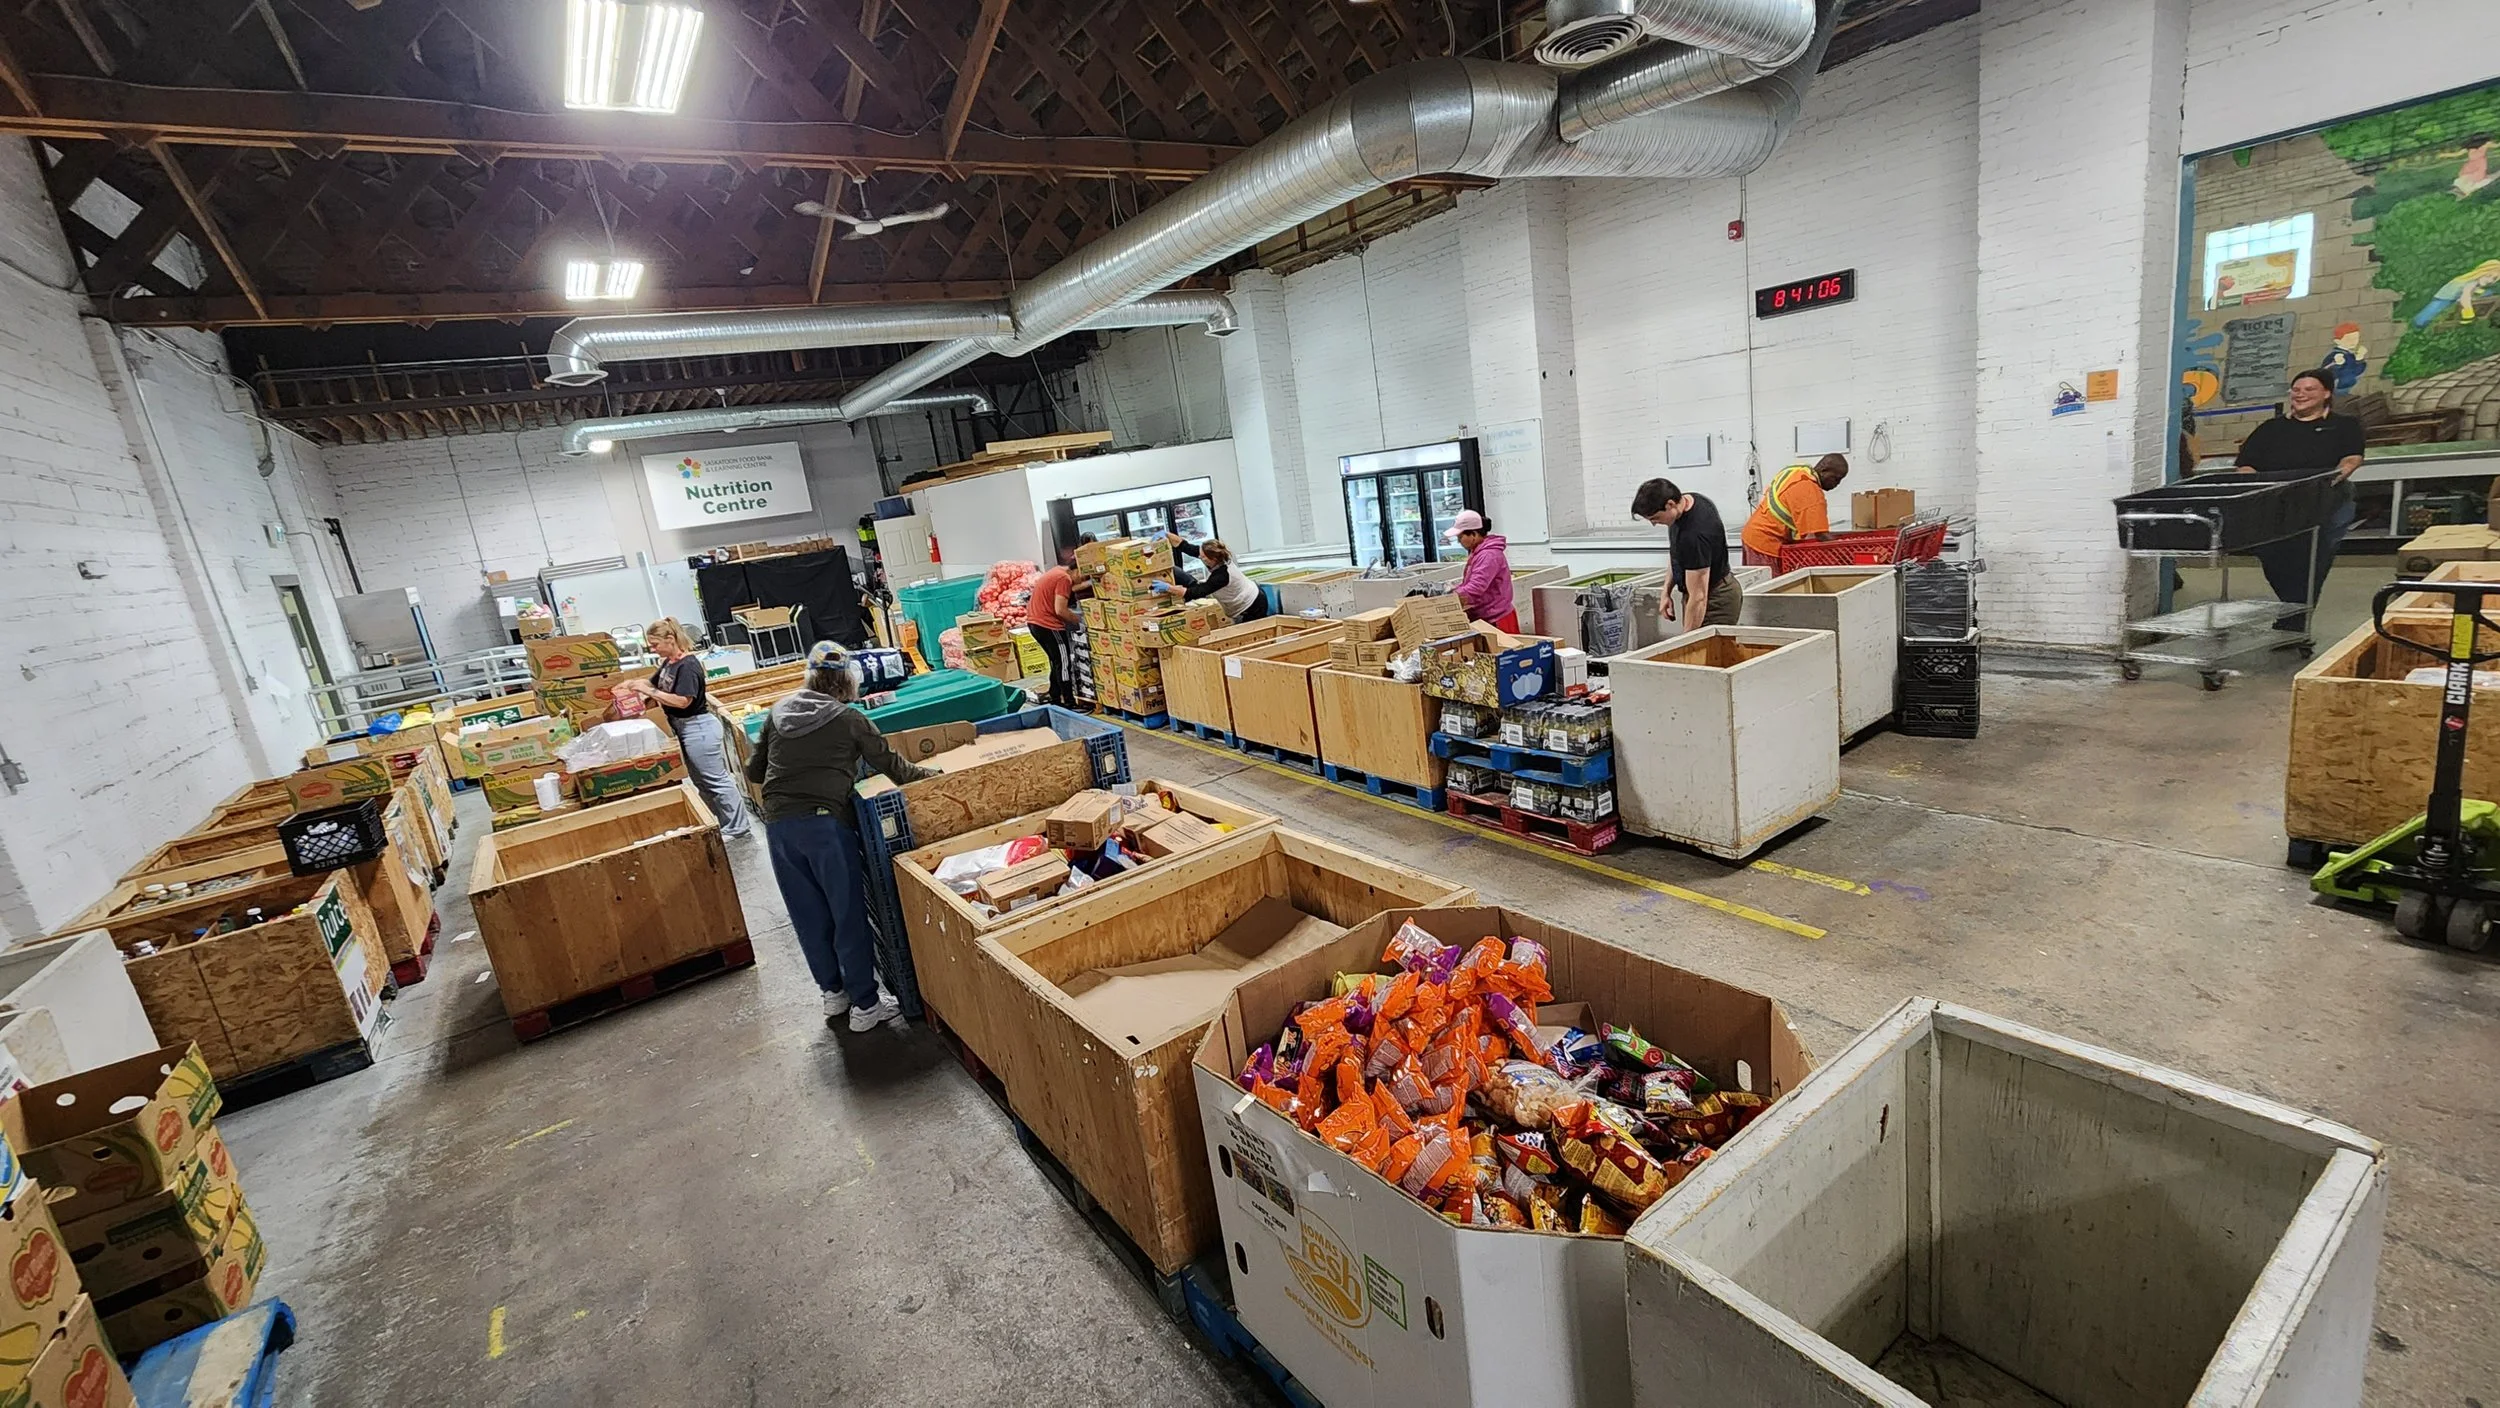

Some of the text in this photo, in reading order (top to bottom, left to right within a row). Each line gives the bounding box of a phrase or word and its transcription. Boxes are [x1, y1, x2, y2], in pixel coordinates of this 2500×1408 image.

[704, 454, 774, 467] SASKATOON FOOD BANK
[711, 463, 743, 473] LEARNING
[743, 461, 768, 470] CENTRE
[685, 479, 773, 501] Nutrition
[703, 497, 768, 515] Centre
[2446, 661, 2471, 705] CLARK
[463, 708, 520, 727] rice &
[488, 773, 531, 787] PLANTAINS
[318, 897, 348, 953] juice
[1224, 1115, 1267, 1149] SUGARY
[1230, 1129, 1273, 1163] & SALTY
[1236, 1143, 1278, 1177] SNACKS
[1284, 1286, 1325, 1326] GROWN
[1326, 1320, 1338, 1338] IN
